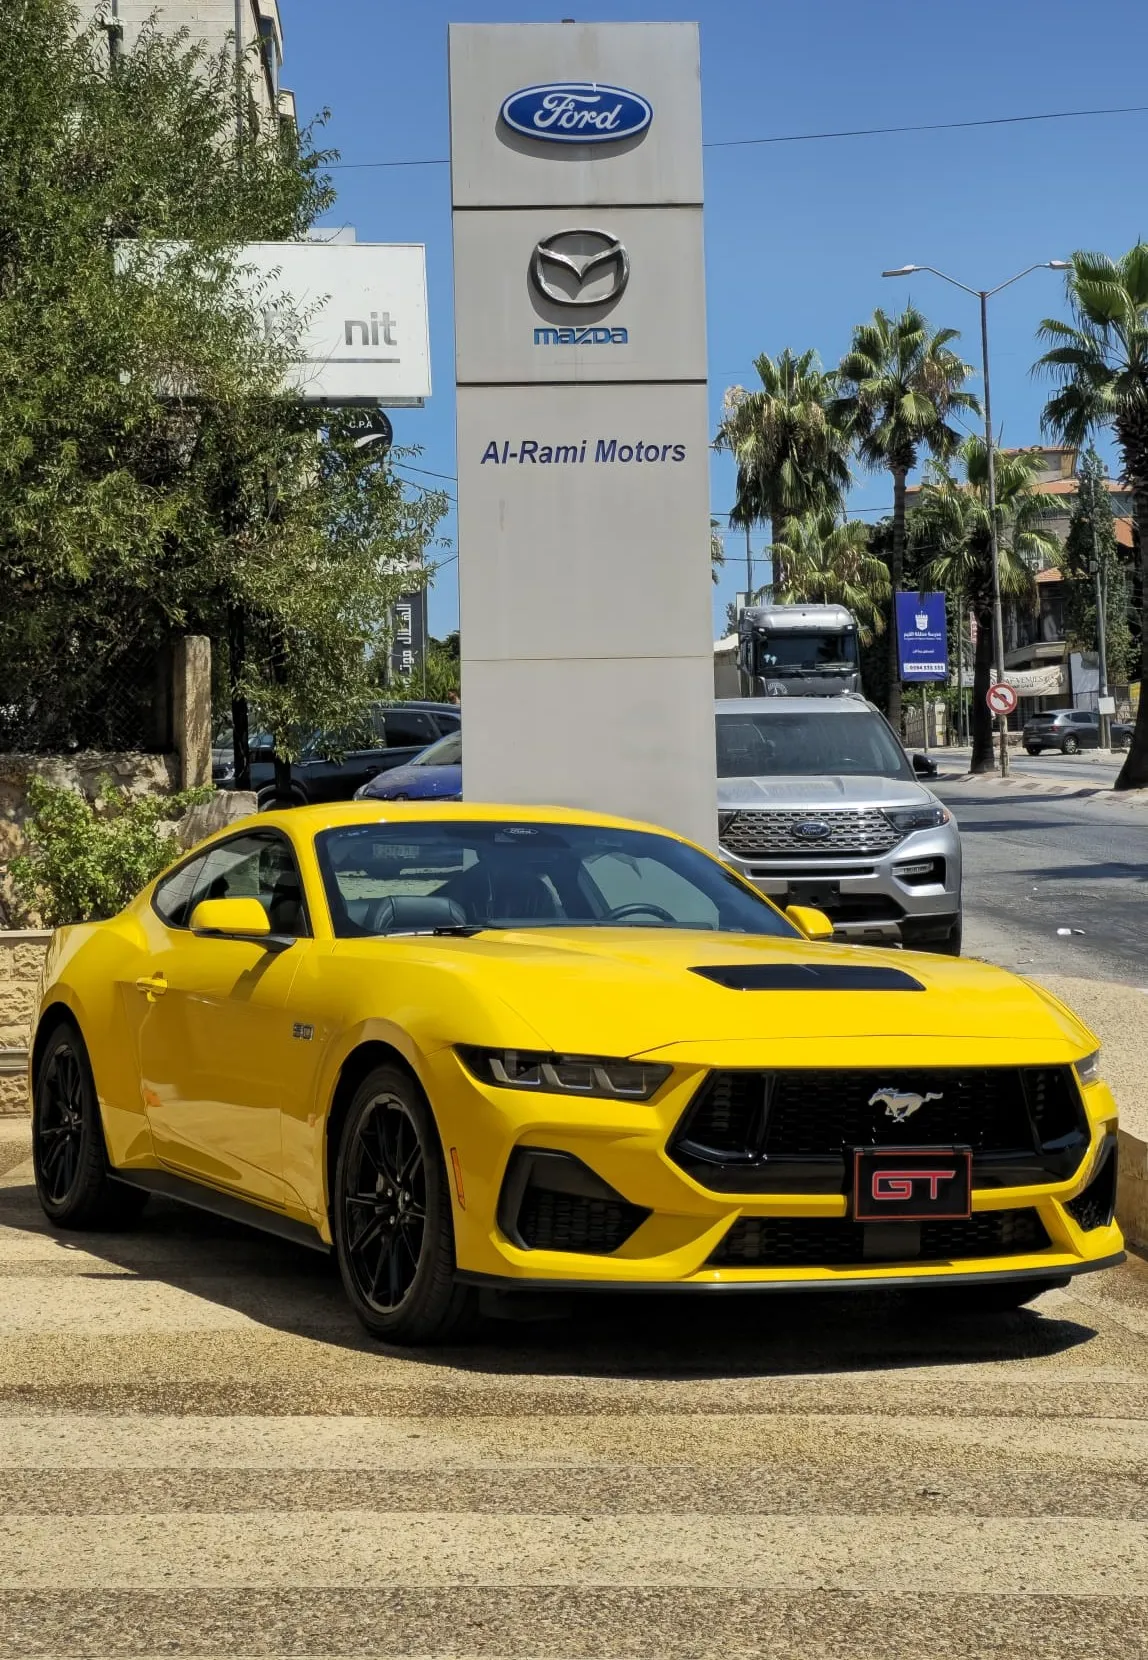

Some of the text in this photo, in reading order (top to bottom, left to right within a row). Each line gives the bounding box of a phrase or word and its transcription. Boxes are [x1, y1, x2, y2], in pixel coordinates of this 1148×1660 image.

[533, 93, 623, 130] Ford
[344, 311, 398, 346] nit
[533, 327, 628, 345] mazda
[480, 438, 687, 465] Al-Rami Motors
[871, 1170, 956, 1200] GT
